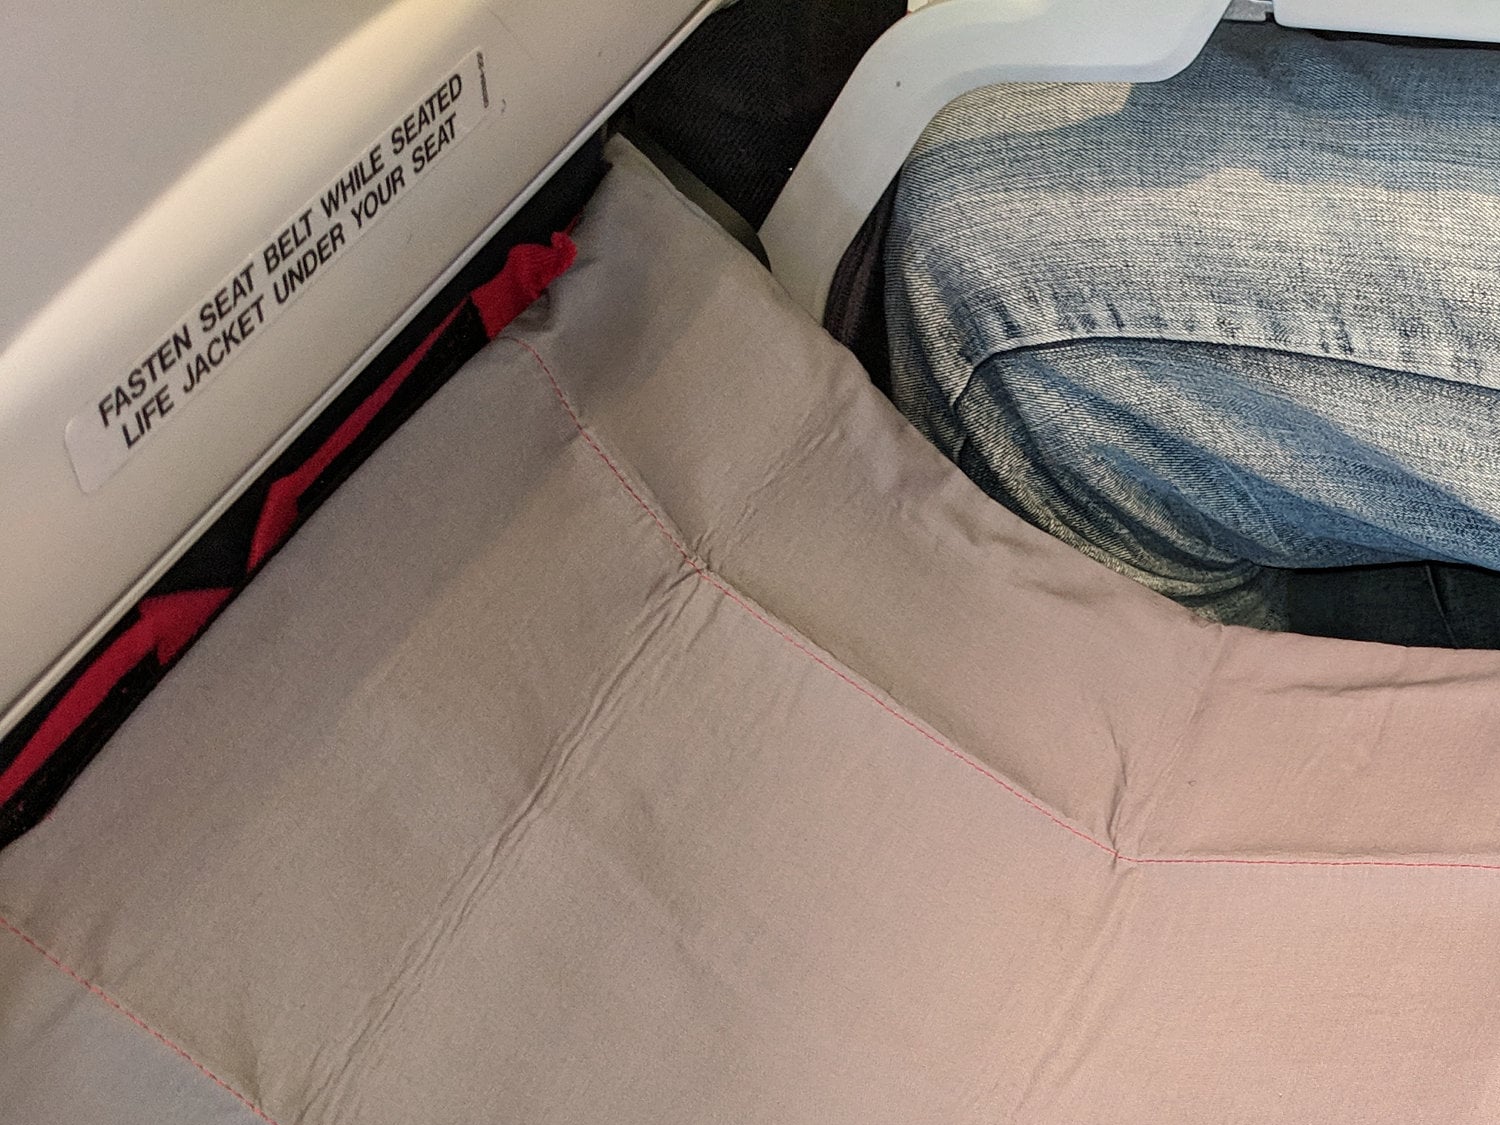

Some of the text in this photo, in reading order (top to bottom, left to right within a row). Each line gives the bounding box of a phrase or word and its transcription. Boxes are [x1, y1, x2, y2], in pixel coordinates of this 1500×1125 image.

[98, 73, 462, 428] FASTEN SEAT BELT WHILE SEATED
[122, 112, 457, 450] LIFE JACKET UNDER YOUR SEAT
